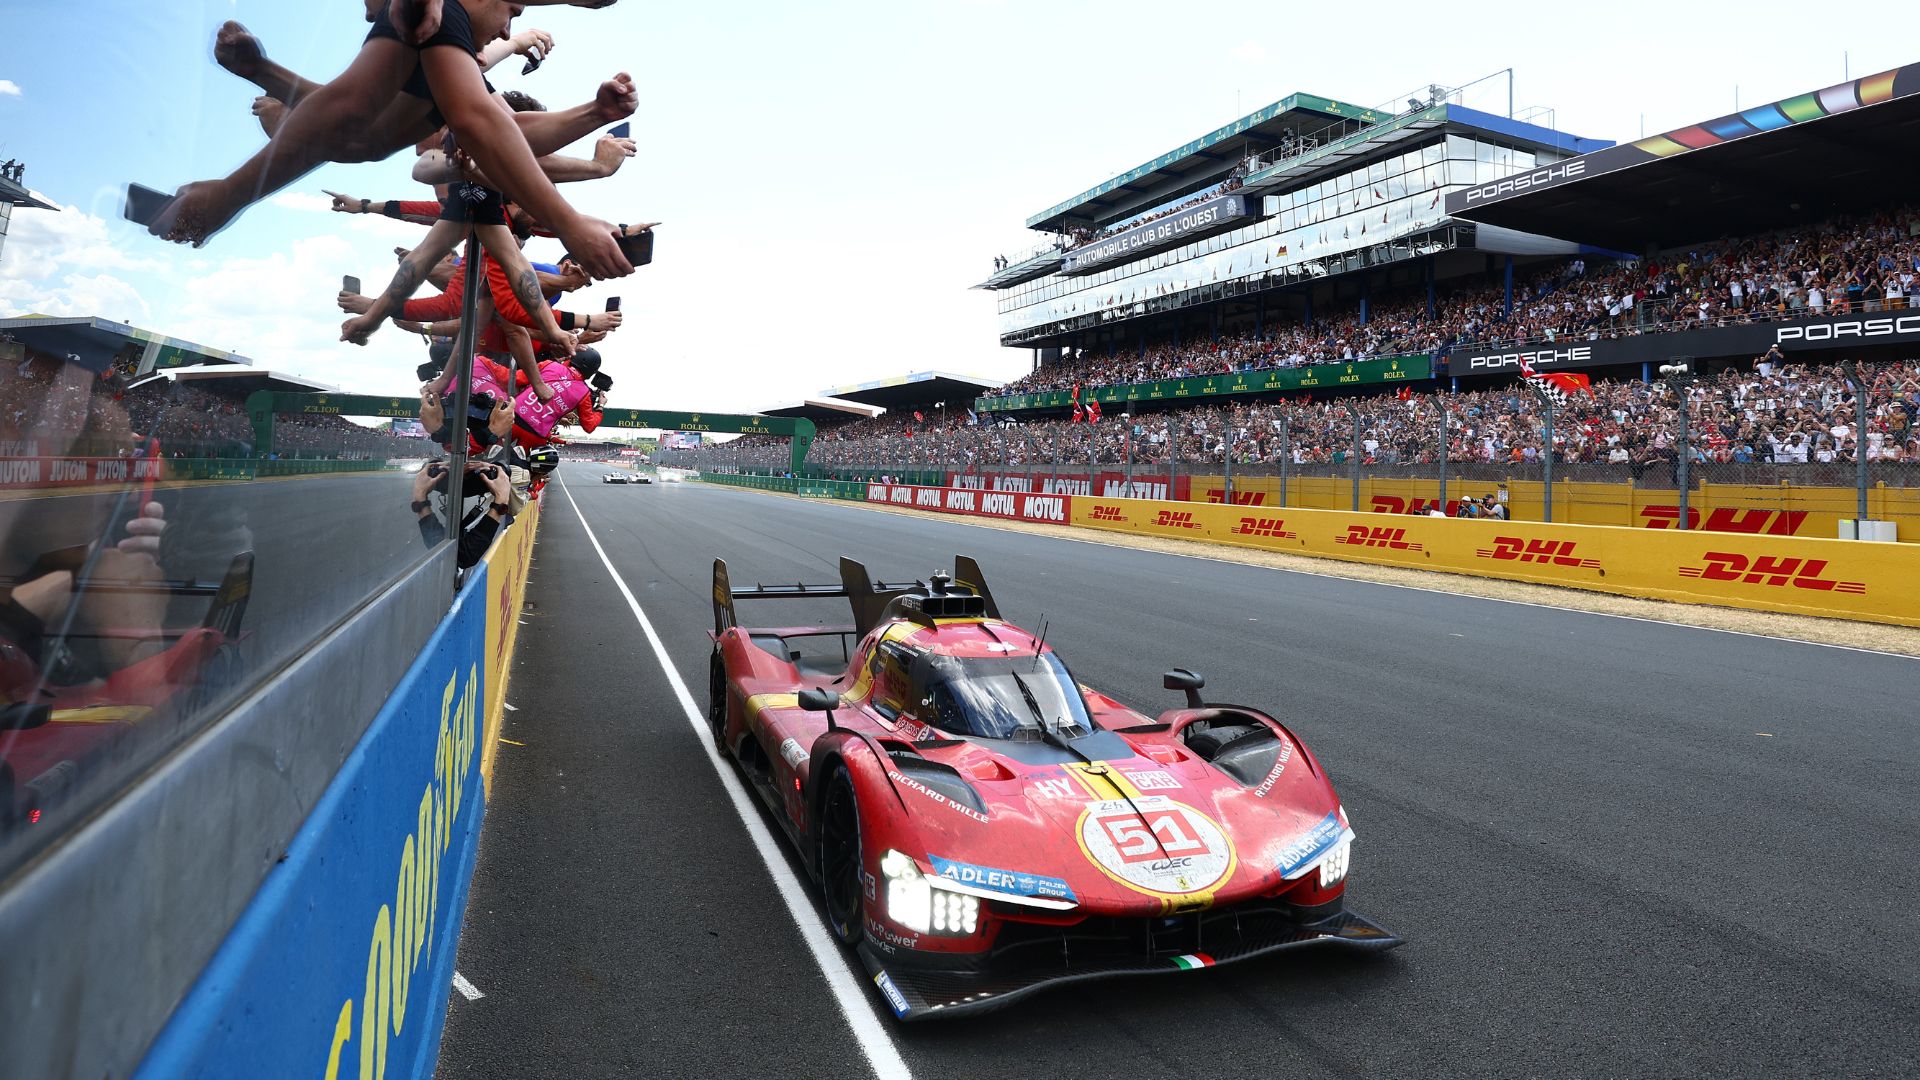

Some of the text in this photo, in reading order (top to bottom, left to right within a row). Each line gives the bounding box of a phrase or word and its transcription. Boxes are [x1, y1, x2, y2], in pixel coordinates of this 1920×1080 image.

[1466, 160, 1586, 204] PORSCHE
[1076, 206, 1219, 266] AUTOMOBILE CLUB DE L'OUEST
[1470, 346, 1591, 369] PORSCHE
[1301, 378, 1318, 386] ROLEX
[1383, 371, 1405, 379] ROLEX
[618, 420, 648, 428] ROLEX
[680, 423, 710, 431] ROLEX
[741, 426, 769, 434] ROLEX
[868, 485, 887, 501] MOTUL
[891, 487, 912, 504] MOTUL
[916, 489, 941, 508] MOTUL
[946, 490, 975, 512] MOTUL
[981, 493, 1015, 516] MOTUL
[1023, 496, 1064, 521] MOTUL
[1093, 505, 1123, 521] DHL
[1158, 511, 1194, 528] DHL
[1239, 517, 1286, 538] DHL
[1346, 526, 1410, 550] DHL
[1492, 536, 1585, 568] DHL
[1700, 551, 1837, 592] DHL
[1254, 741, 1294, 798] RICHARD MILLE
[1034, 778, 1076, 798] HY
[1135, 777, 1177, 788] CAR
[888, 770, 990, 824] RICHARD MILLE
[1105, 815, 1203, 857] 51
[1151, 857, 1192, 871] WEC
[1276, 838, 1320, 870] ADLER
[940, 865, 1016, 889] ADLER
[1038, 887, 1067, 897] GROUP
